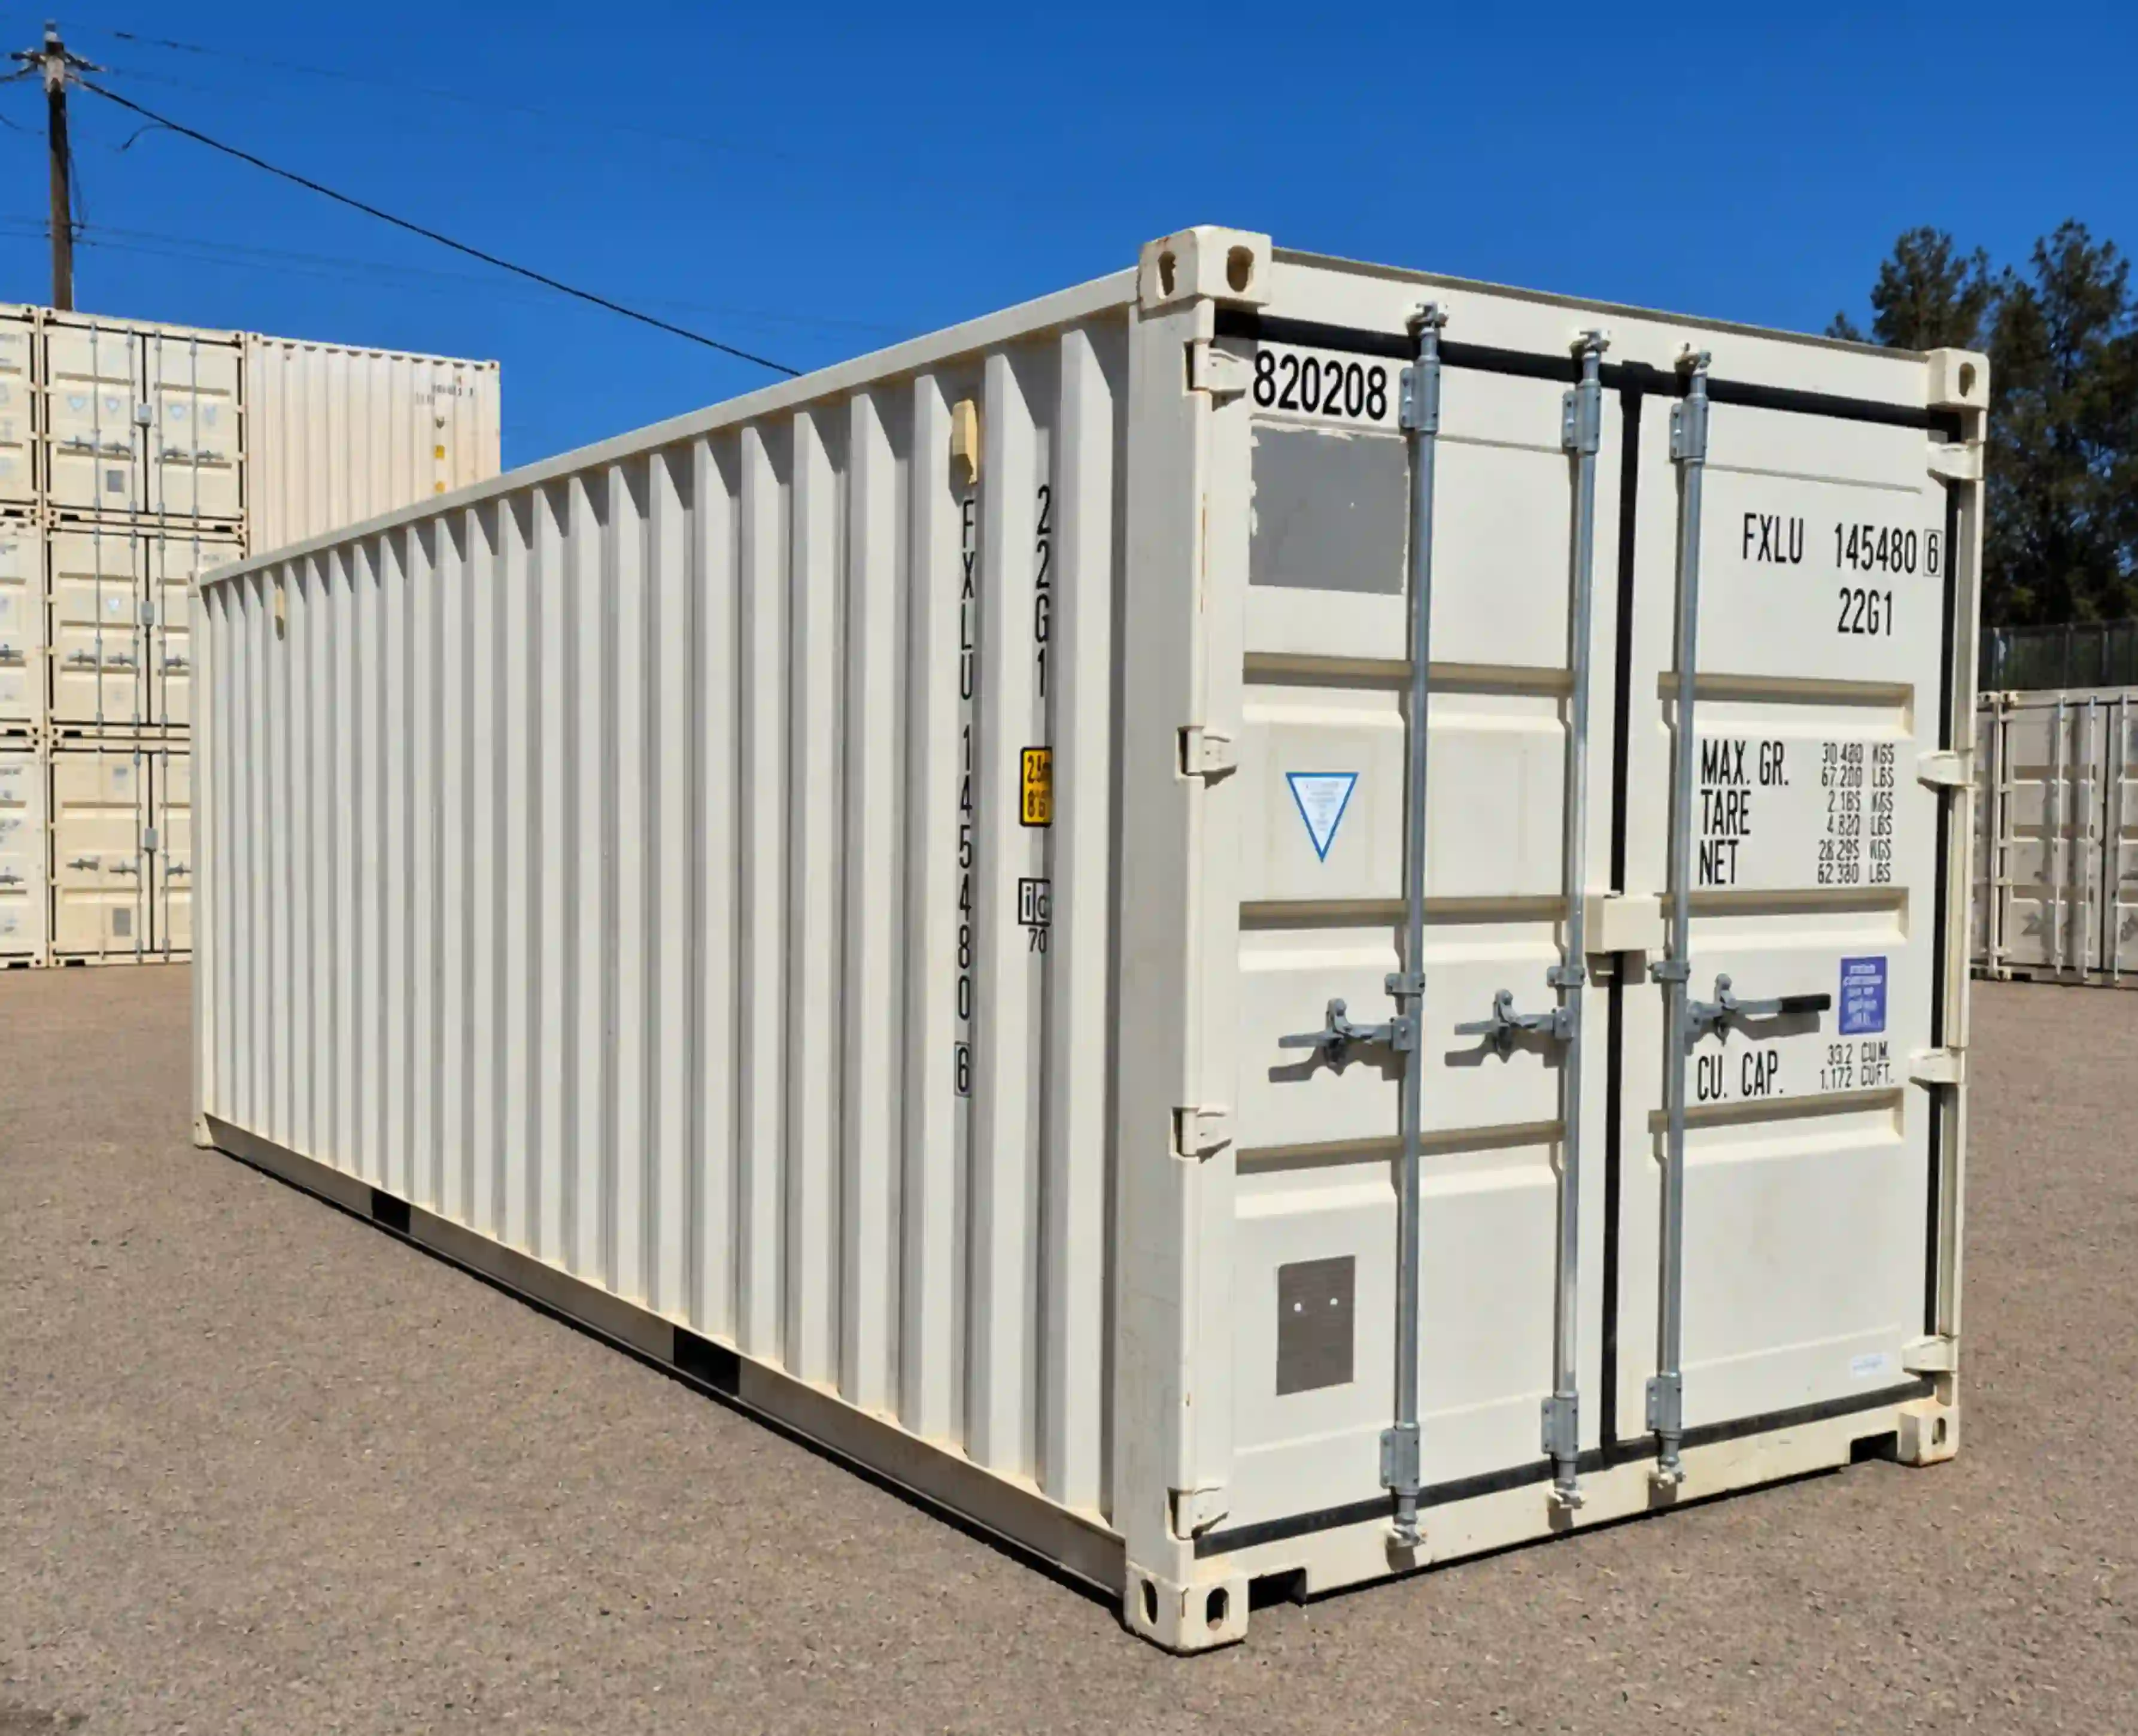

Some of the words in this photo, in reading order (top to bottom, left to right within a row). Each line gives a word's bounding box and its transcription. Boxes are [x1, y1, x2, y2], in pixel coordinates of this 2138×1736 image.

[1253, 350, 1387, 420] 820208
[1742, 512, 1804, 564] FXLU
[1834, 522, 1917, 575] 145480
[1927, 533, 1939, 574] 6
[960, 499, 975, 700] FXLU
[1035, 484, 1052, 698] 22G1
[1837, 587, 1894, 636] 22G1
[1700, 738, 1751, 785] MAX.
[1759, 740, 1789, 787] GR.
[1872, 742, 1894, 764] KGS
[1872, 766, 1894, 788] LBS
[1700, 789, 1751, 836] TARE
[1870, 814, 1893, 836] LBS
[958, 724, 973, 1021] 145480
[1699, 839, 1739, 885] NET
[1869, 862, 1891, 884] LBS
[1028, 928, 1047, 954] 70
[958, 1046, 970, 1092] 6
[1697, 1055, 1727, 1101] CU.
[1741, 1049, 1784, 1097] CAP.
